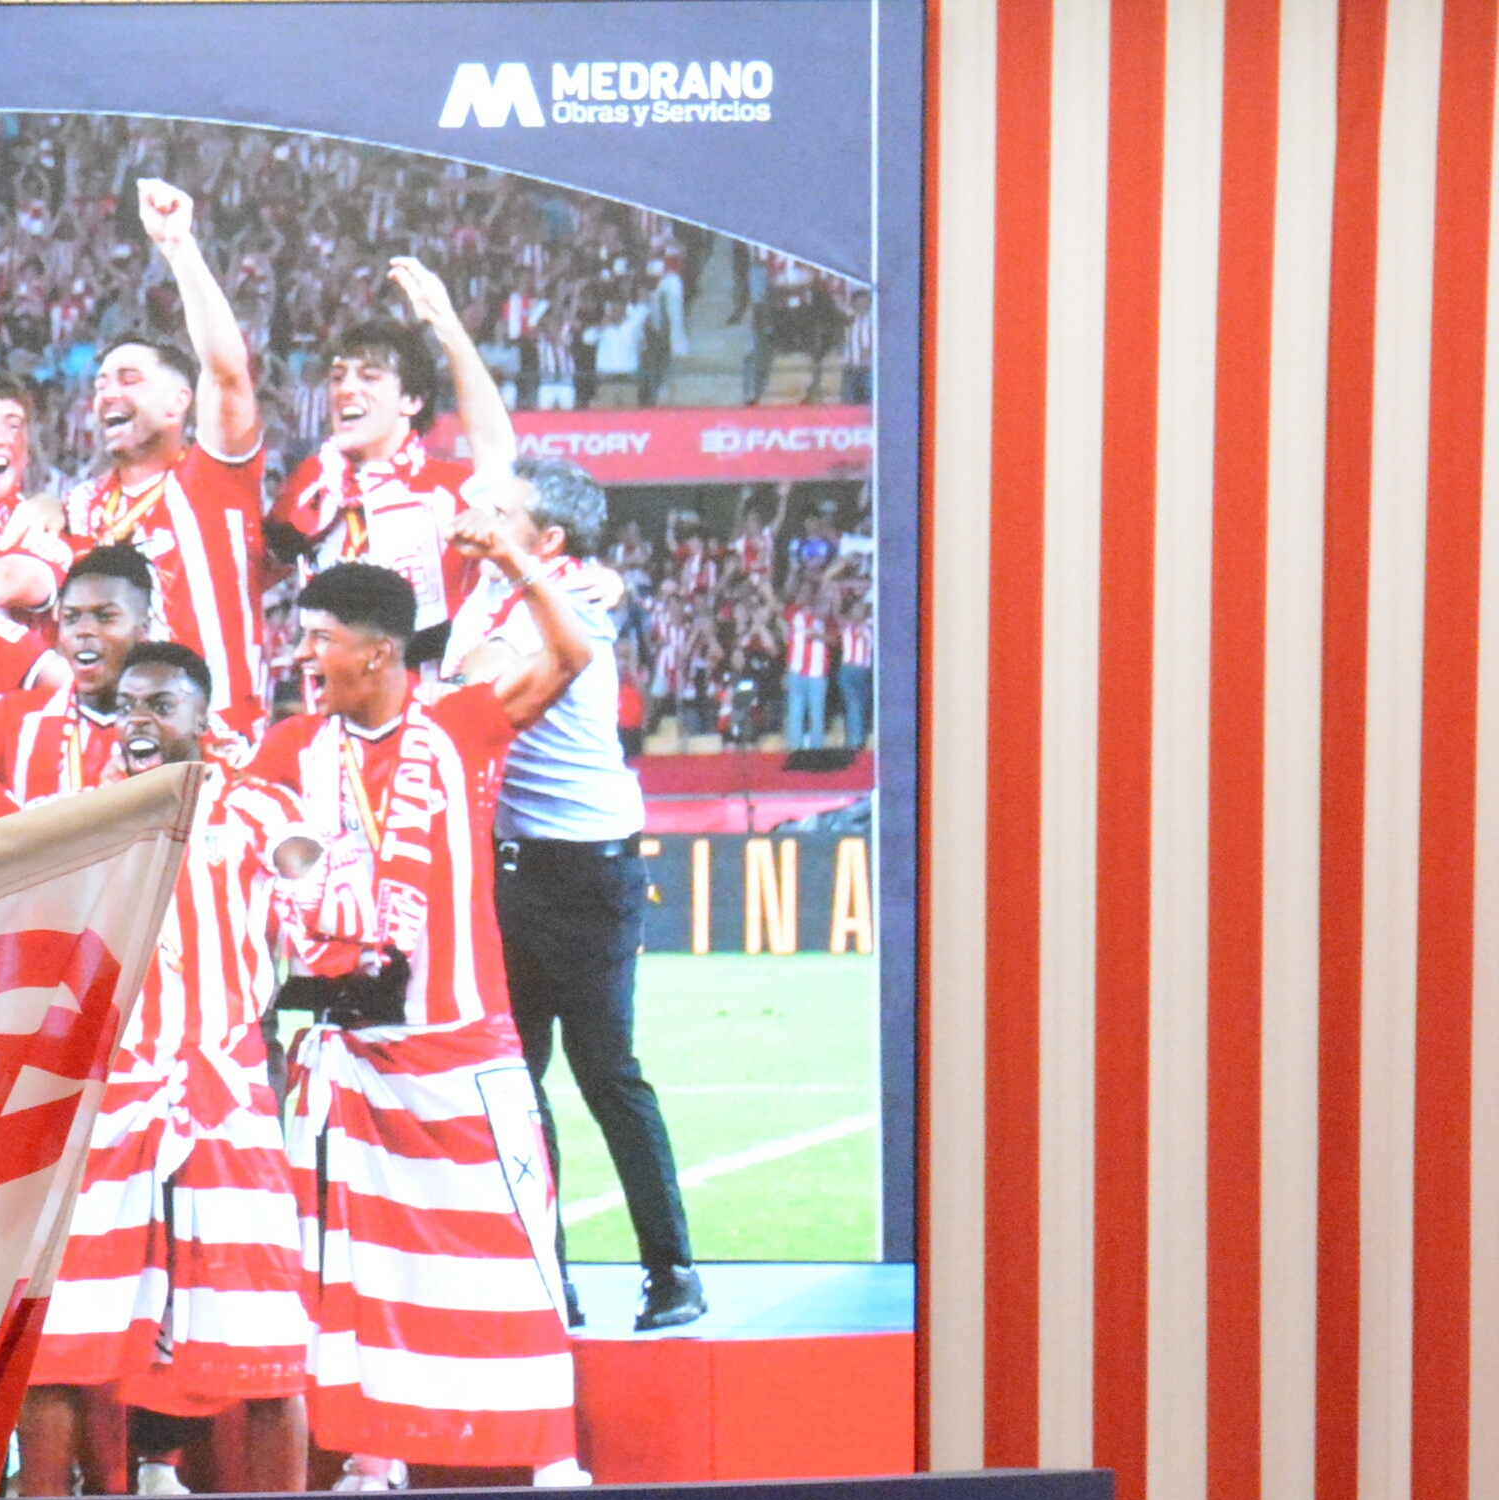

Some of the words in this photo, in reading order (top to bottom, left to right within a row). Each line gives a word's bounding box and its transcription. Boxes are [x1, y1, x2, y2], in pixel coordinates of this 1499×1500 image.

[551, 60, 774, 101] MEDRANO
[551, 101, 630, 124] Obras
[632, 104, 650, 127] y
[651, 101, 772, 122] Servicios
[638, 837, 875, 956] INA
